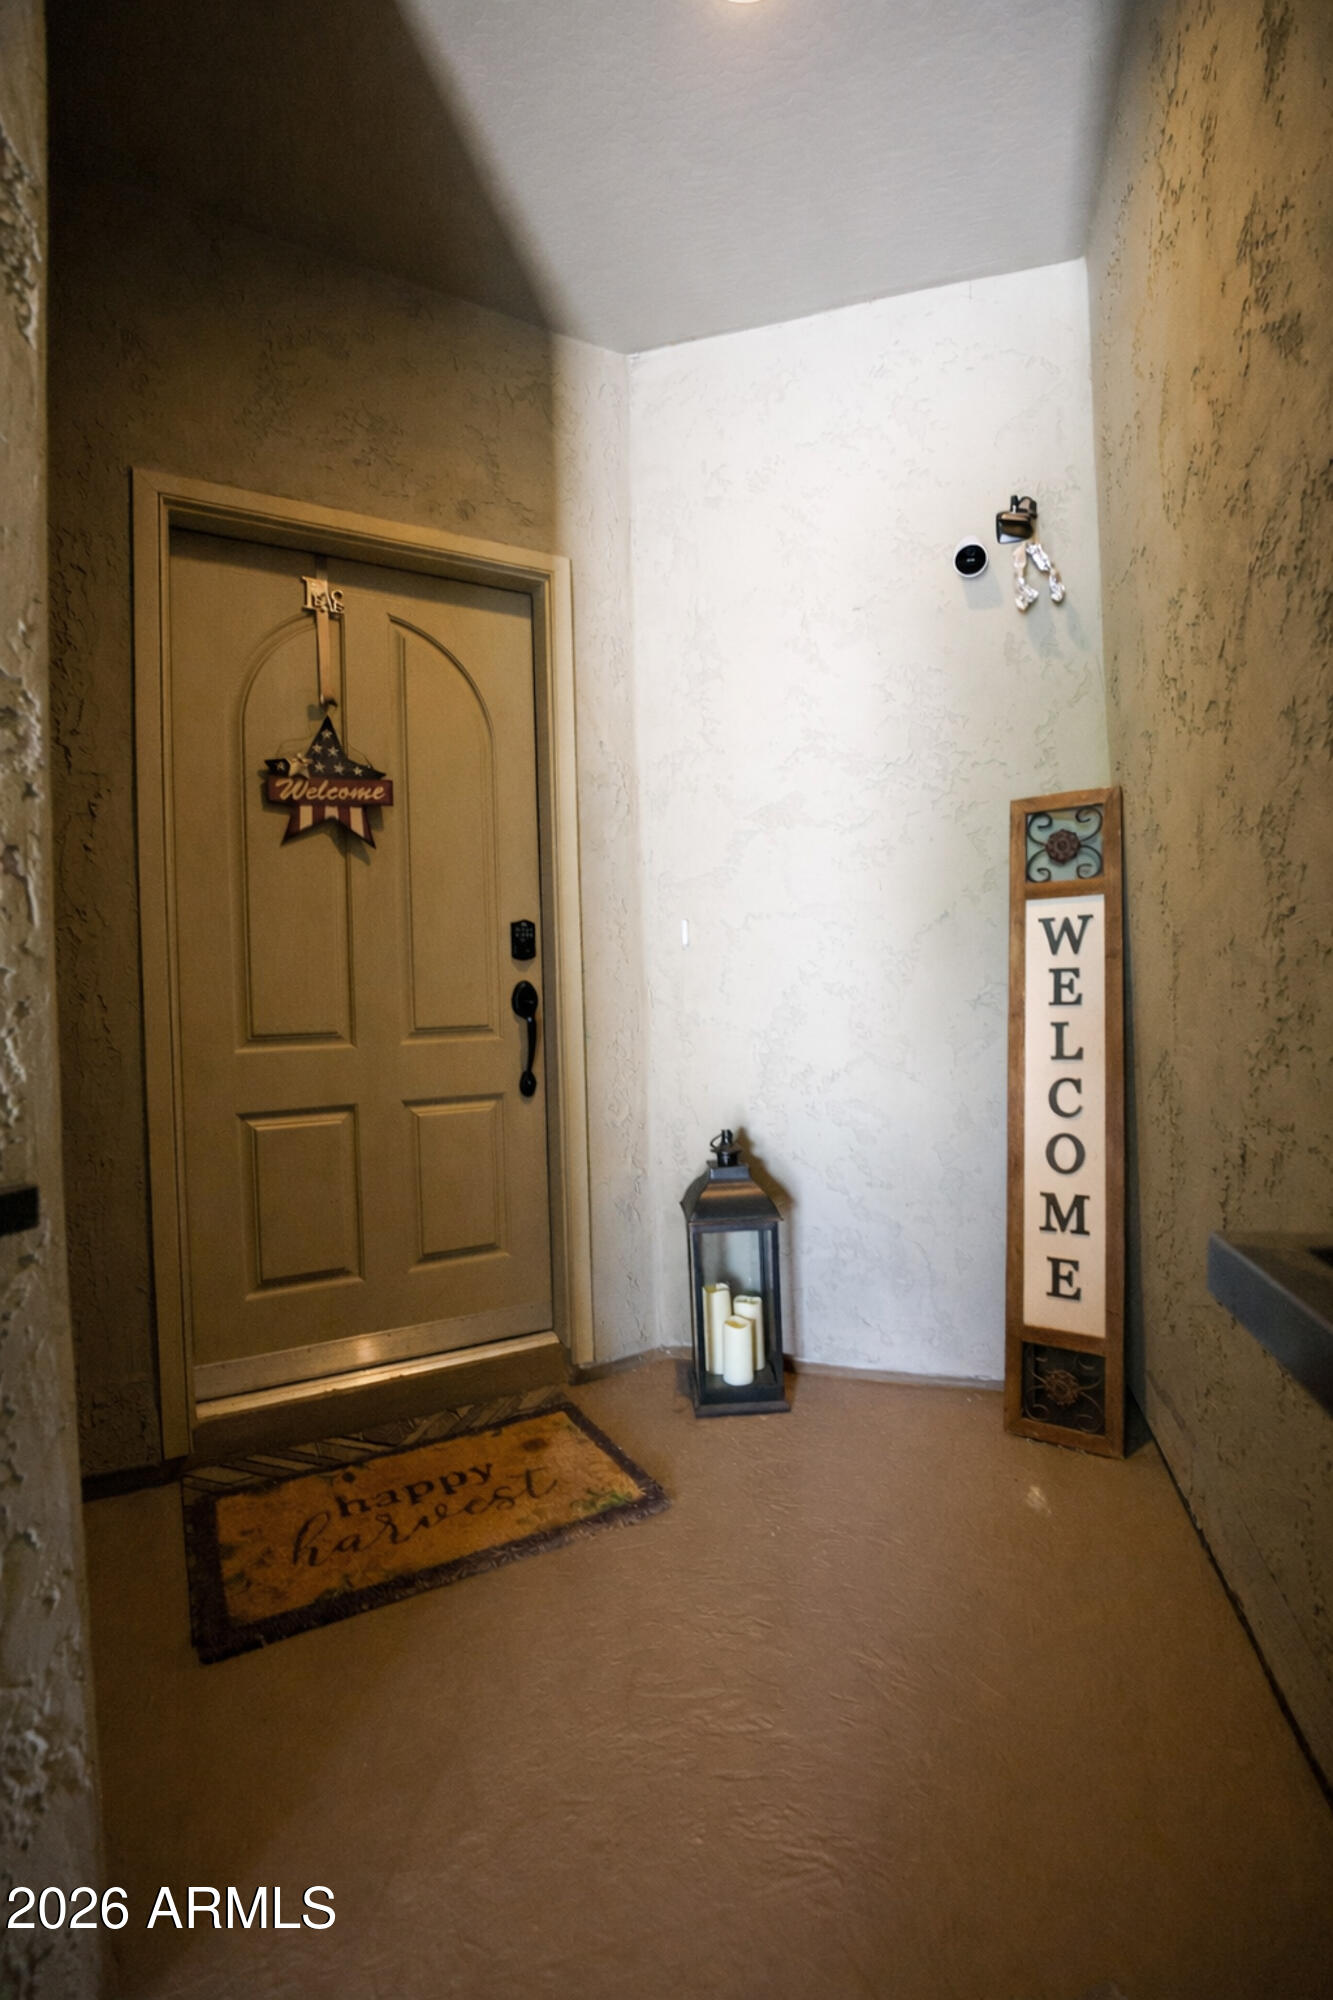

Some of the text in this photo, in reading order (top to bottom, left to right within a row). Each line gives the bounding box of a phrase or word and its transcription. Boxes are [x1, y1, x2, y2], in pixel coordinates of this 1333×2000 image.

[275, 779, 386, 802] Welcome
[1038, 914, 1094, 1301] WELCOME
[293, 1468, 558, 1567] harvest
[339, 1464, 494, 1518] happy
